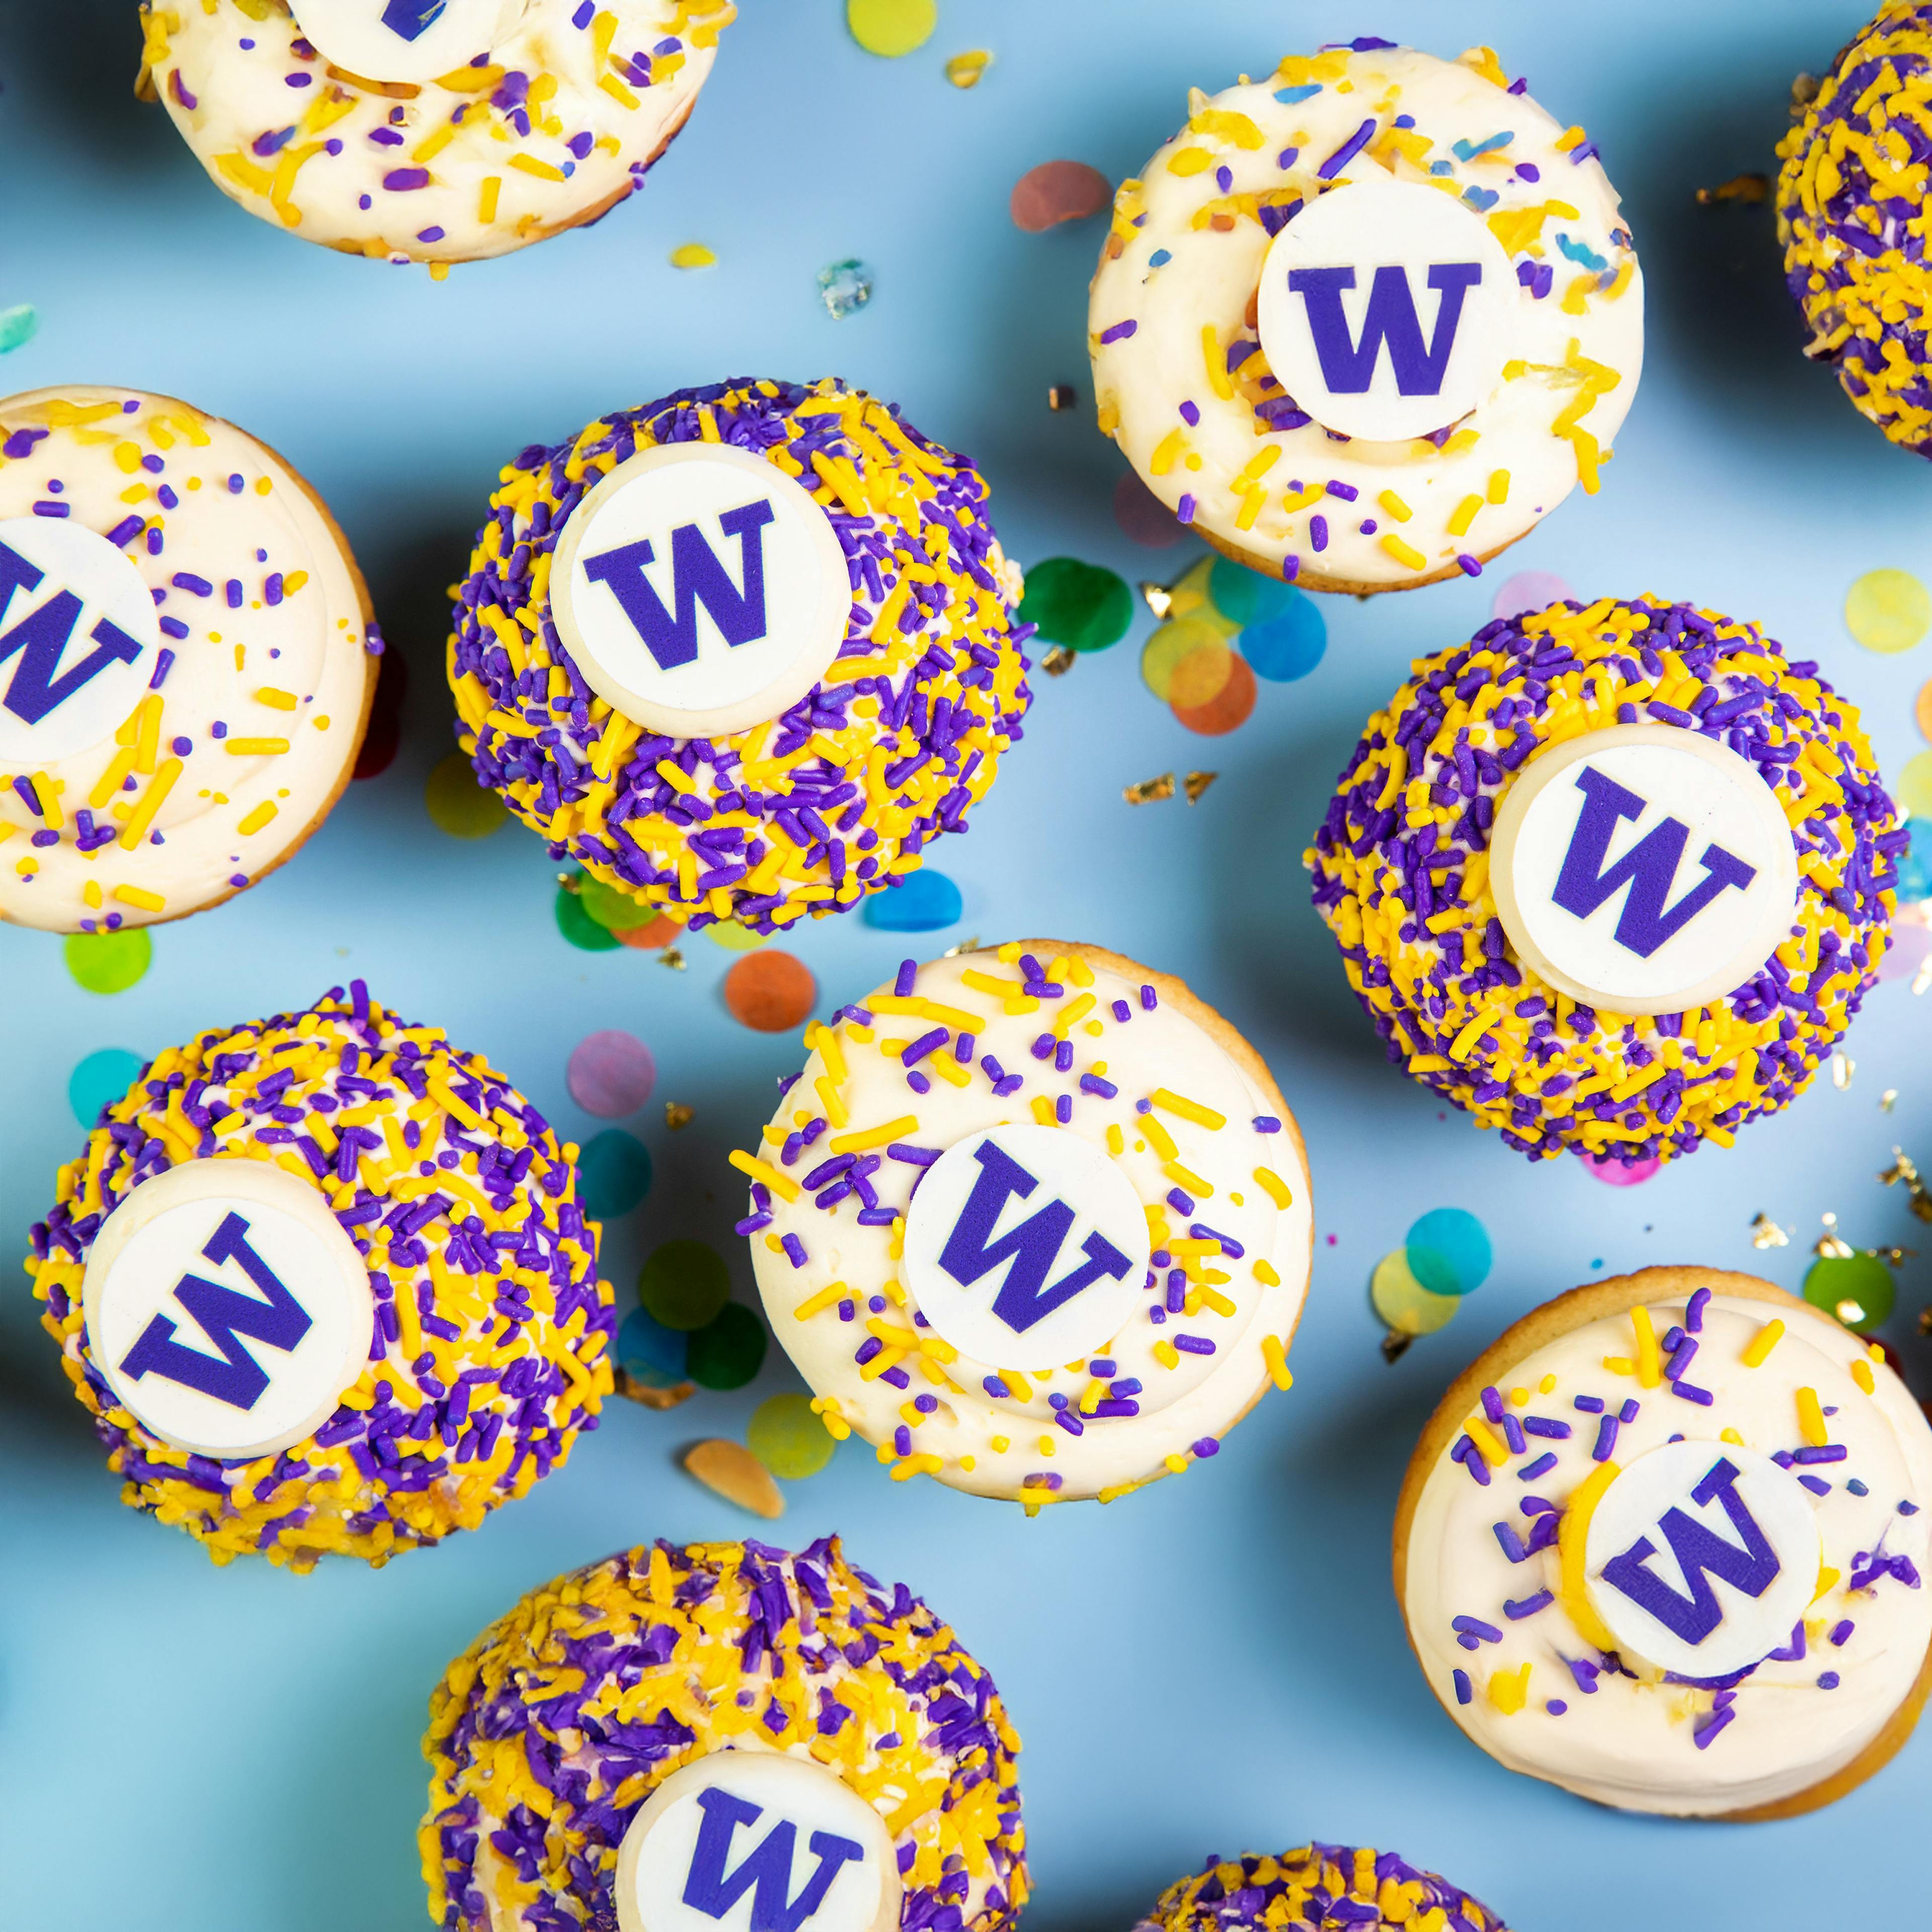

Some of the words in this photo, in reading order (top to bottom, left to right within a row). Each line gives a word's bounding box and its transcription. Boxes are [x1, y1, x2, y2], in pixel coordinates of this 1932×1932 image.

[1289, 264, 1481, 396] W
[0, 541, 143, 725] W
[585, 500, 775, 670] W
[1552, 765, 1757, 958] W
[120, 1212, 312, 1410] W
[938, 1140, 1133, 1333] W
[1602, 1457, 1781, 1645] W
[683, 1788, 864, 1932] W
